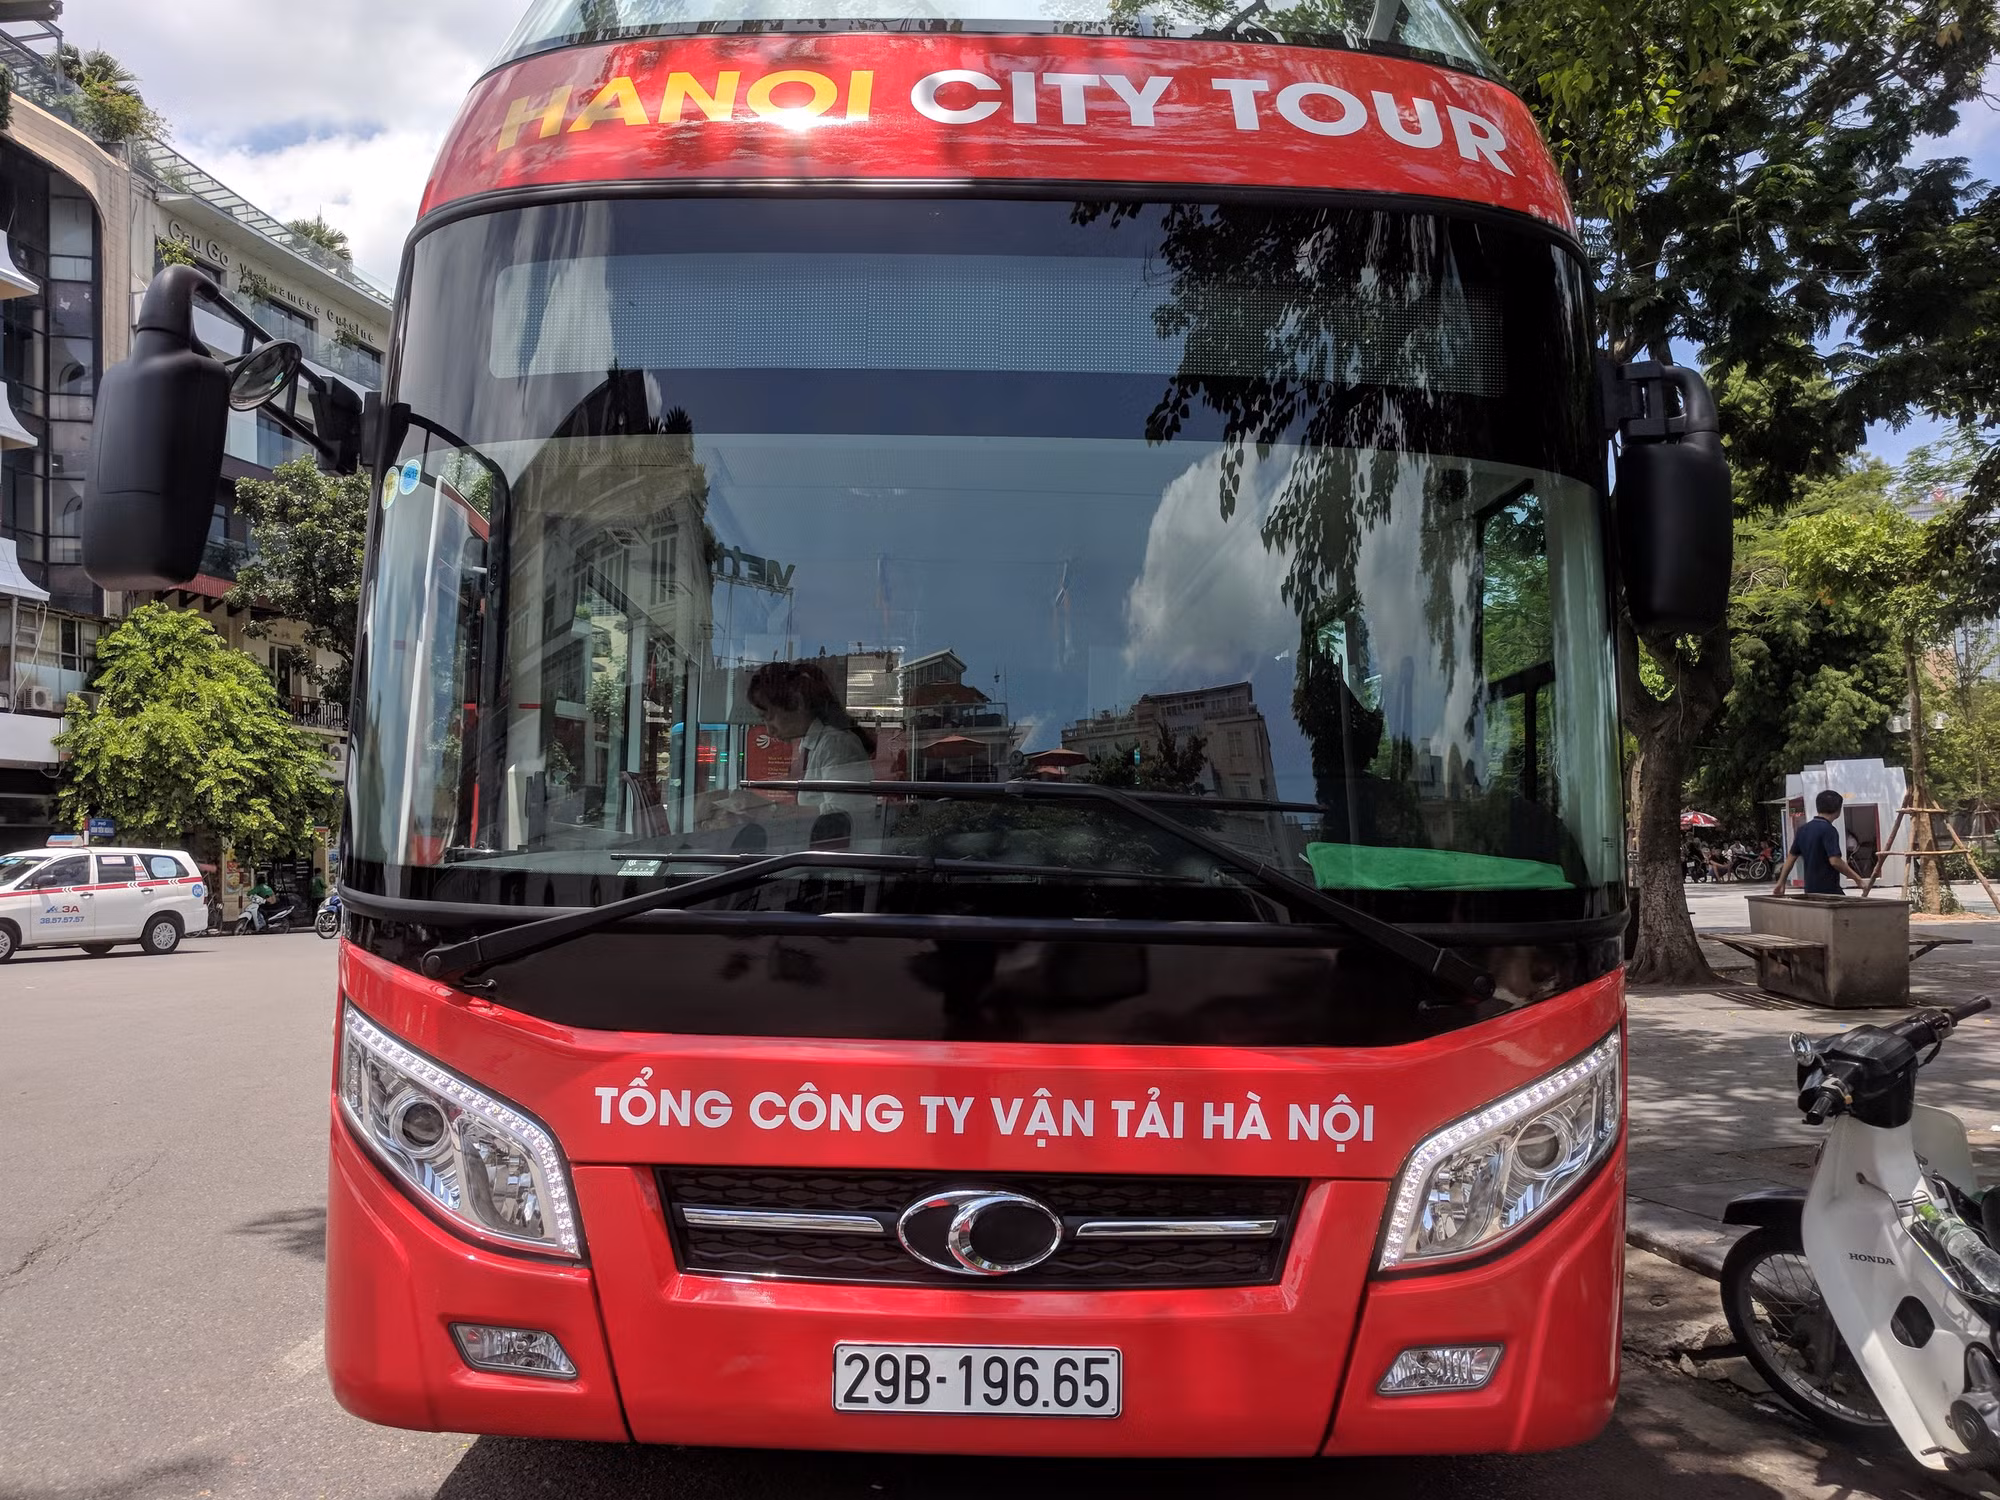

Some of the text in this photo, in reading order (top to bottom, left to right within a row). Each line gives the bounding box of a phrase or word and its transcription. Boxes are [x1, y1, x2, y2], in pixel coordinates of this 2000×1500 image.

[496, 69, 1515, 176] HANOI CITY TOUR
[169, 220, 203, 253] Cau
[207, 240, 229, 267] Go
[327, 308, 375, 343] Cuisine
[40, 915, 85, 925] 38.57.57.57
[594, 1066, 1374, 1152] TỔNG CÔNG TY VẬN TẢI HÀ NỘI
[1848, 1253, 1896, 1266] HONDA
[843, 1353, 1110, 1409] 29B-196.65
